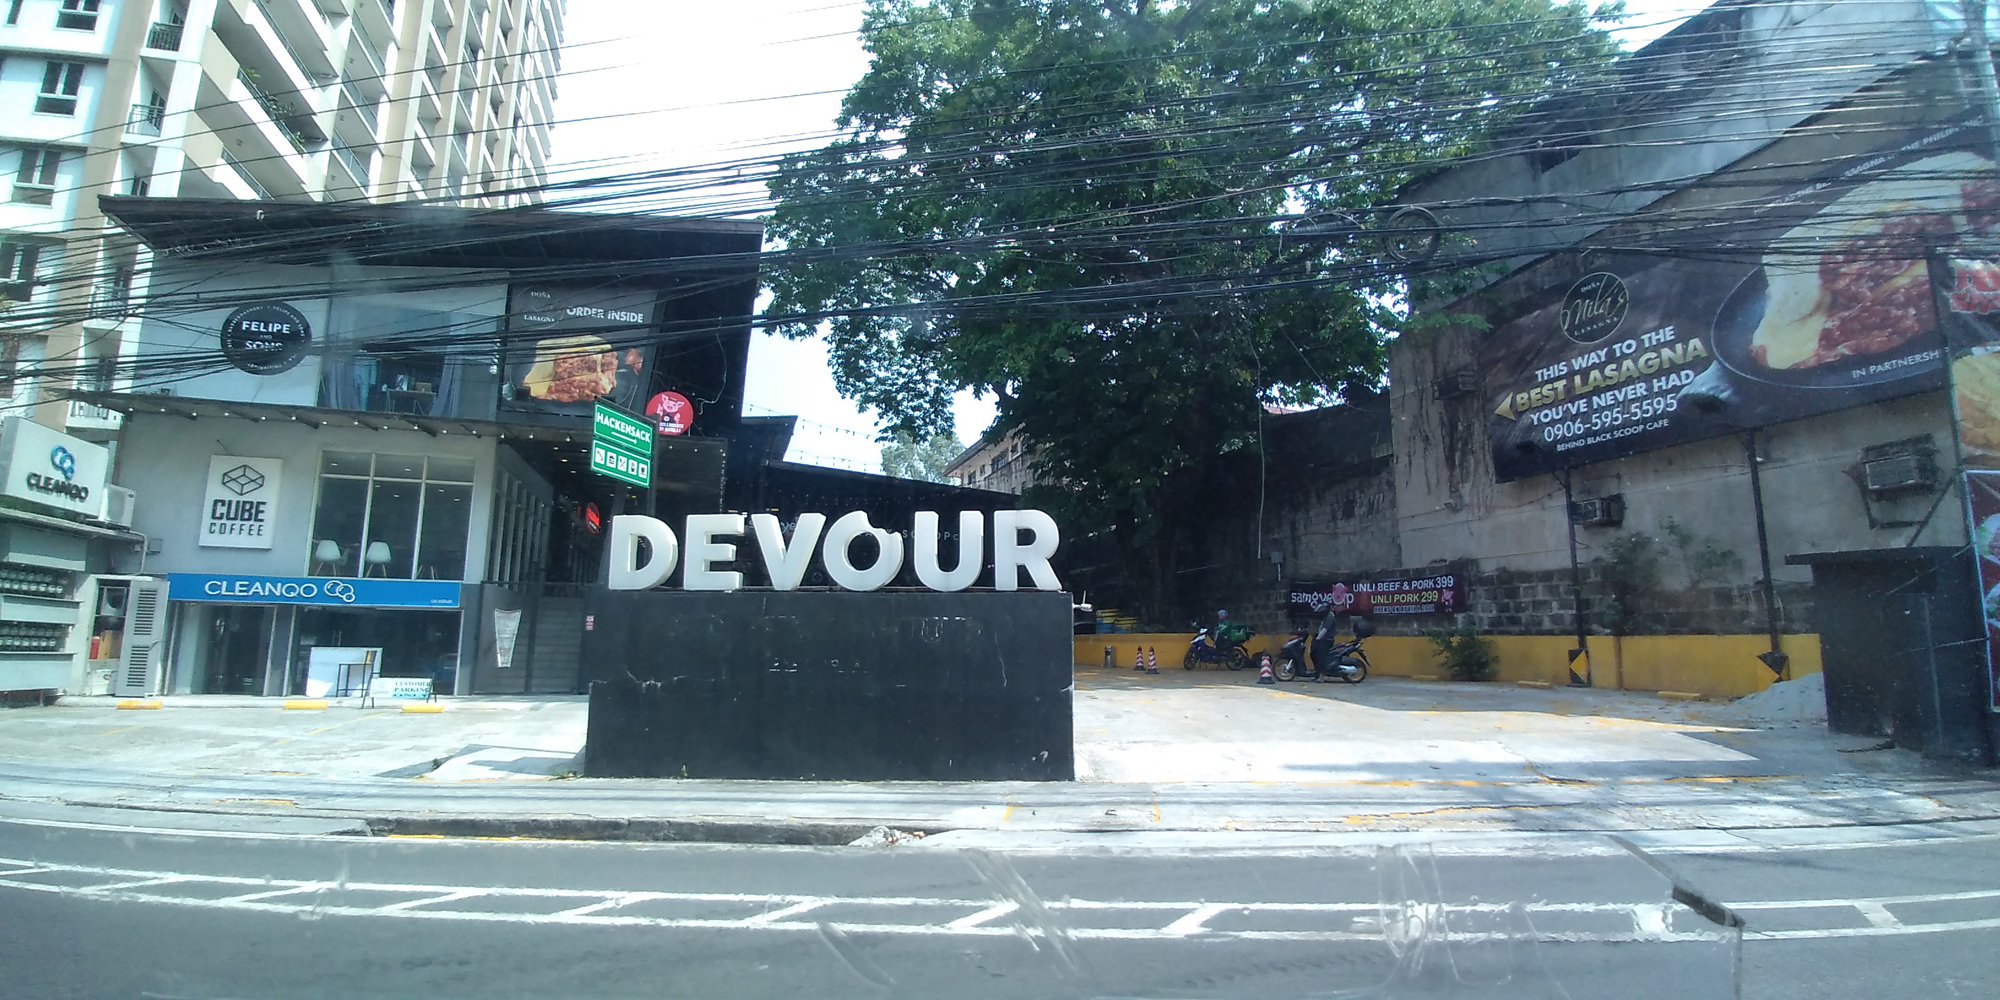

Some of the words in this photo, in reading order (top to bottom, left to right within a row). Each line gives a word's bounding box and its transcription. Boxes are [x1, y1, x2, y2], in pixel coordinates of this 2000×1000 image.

[241, 320, 291, 334] FELIPE
[566, 306, 605, 319] ORDER
[607, 311, 644, 324] INSIDE
[1574, 316, 1618, 336] LASAGNA
[1535, 362, 1568, 382] THIS
[1571, 348, 1609, 371] WAY
[1612, 339, 1637, 358] TO
[1641, 326, 1676, 348] THE
[1852, 367, 1866, 379] IN
[1869, 349, 1940, 375] PARTNERSH
[1515, 378, 1568, 412] BEST
[1573, 337, 1709, 395] LASAGNA
[1530, 399, 1589, 426] YOU'VE
[1593, 382, 1648, 408] NEVER
[1652, 369, 1695, 392] HAD
[596, 411, 651, 443] HACKENSACK
[1543, 393, 1678, 442] 0906-595-5595
[1557, 437, 1585, 451] BEHIND
[1587, 432, 1612, 445] BLACK
[1614, 424, 1644, 438] SCOOP
[1646, 418, 1670, 431] CAFE
[26, 472, 89, 503] CLEANQO
[211, 498, 267, 522] CUBE
[209, 522, 265, 536] COFFEE
[608, 509, 1063, 592] DEVOUR
[204, 580, 318, 598] CLEANQO
[1353, 583, 1375, 592] UNLI
[1377, 582, 1400, 591] BEEF
[1402, 581, 1410, 591] &
[1411, 579, 1434, 590] PORK
[1436, 576, 1454, 588] 399
[1370, 594, 1392, 604] UNLI
[1394, 593, 1419, 603] PORK
[1421, 591, 1438, 602] 299
